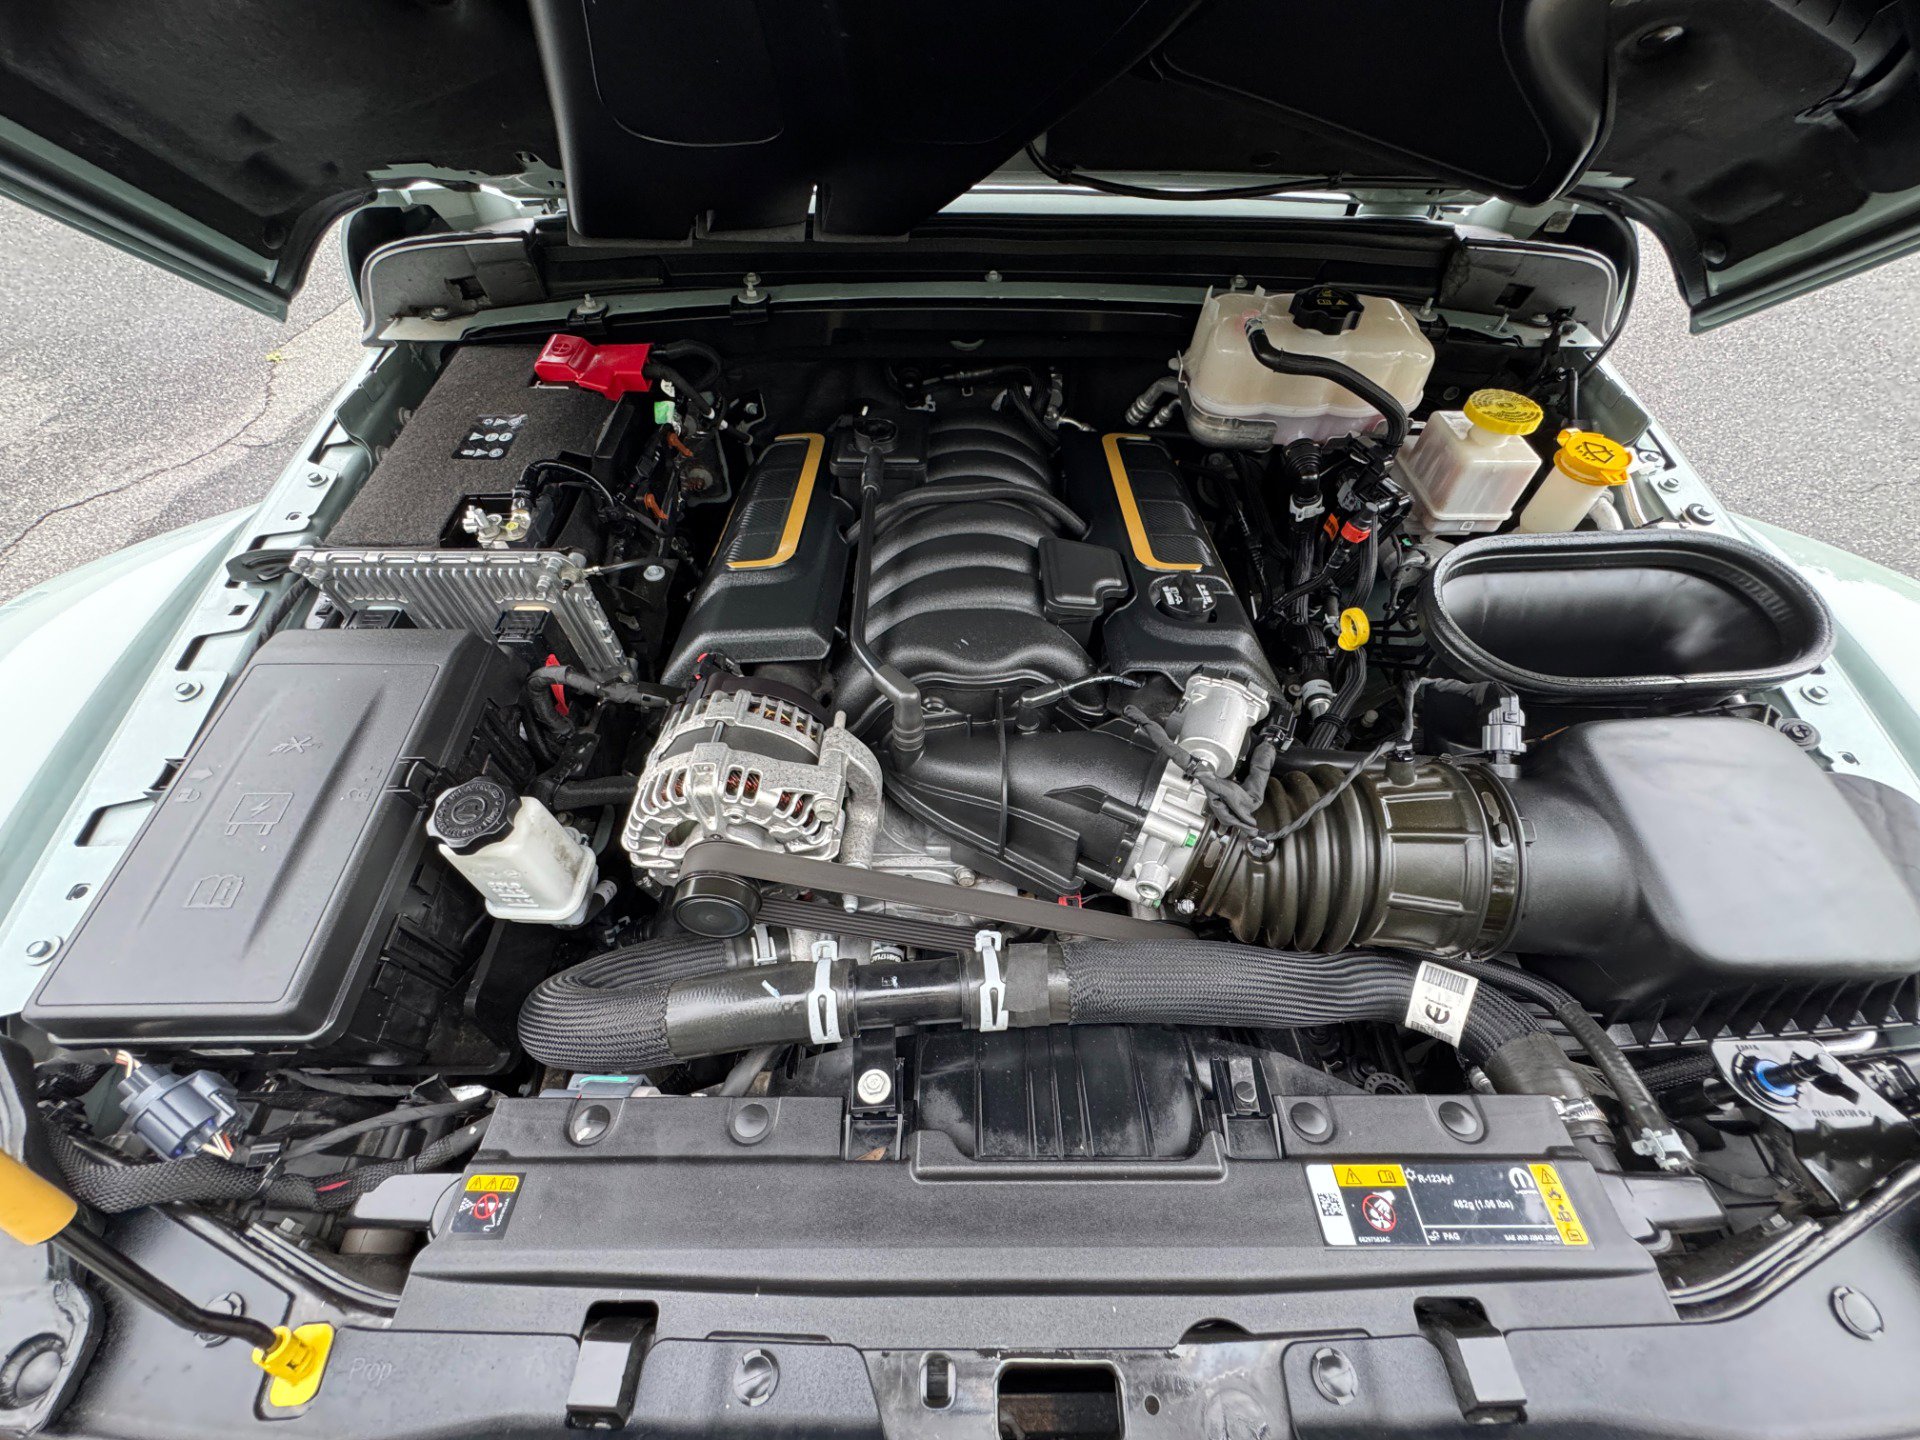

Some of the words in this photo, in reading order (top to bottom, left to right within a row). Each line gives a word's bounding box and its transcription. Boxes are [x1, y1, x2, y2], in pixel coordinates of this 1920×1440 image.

[1453, 1199, 1475, 1211] 482g
[1443, 1232, 1461, 1241] PAG
[348, 1357, 393, 1387] Prop
